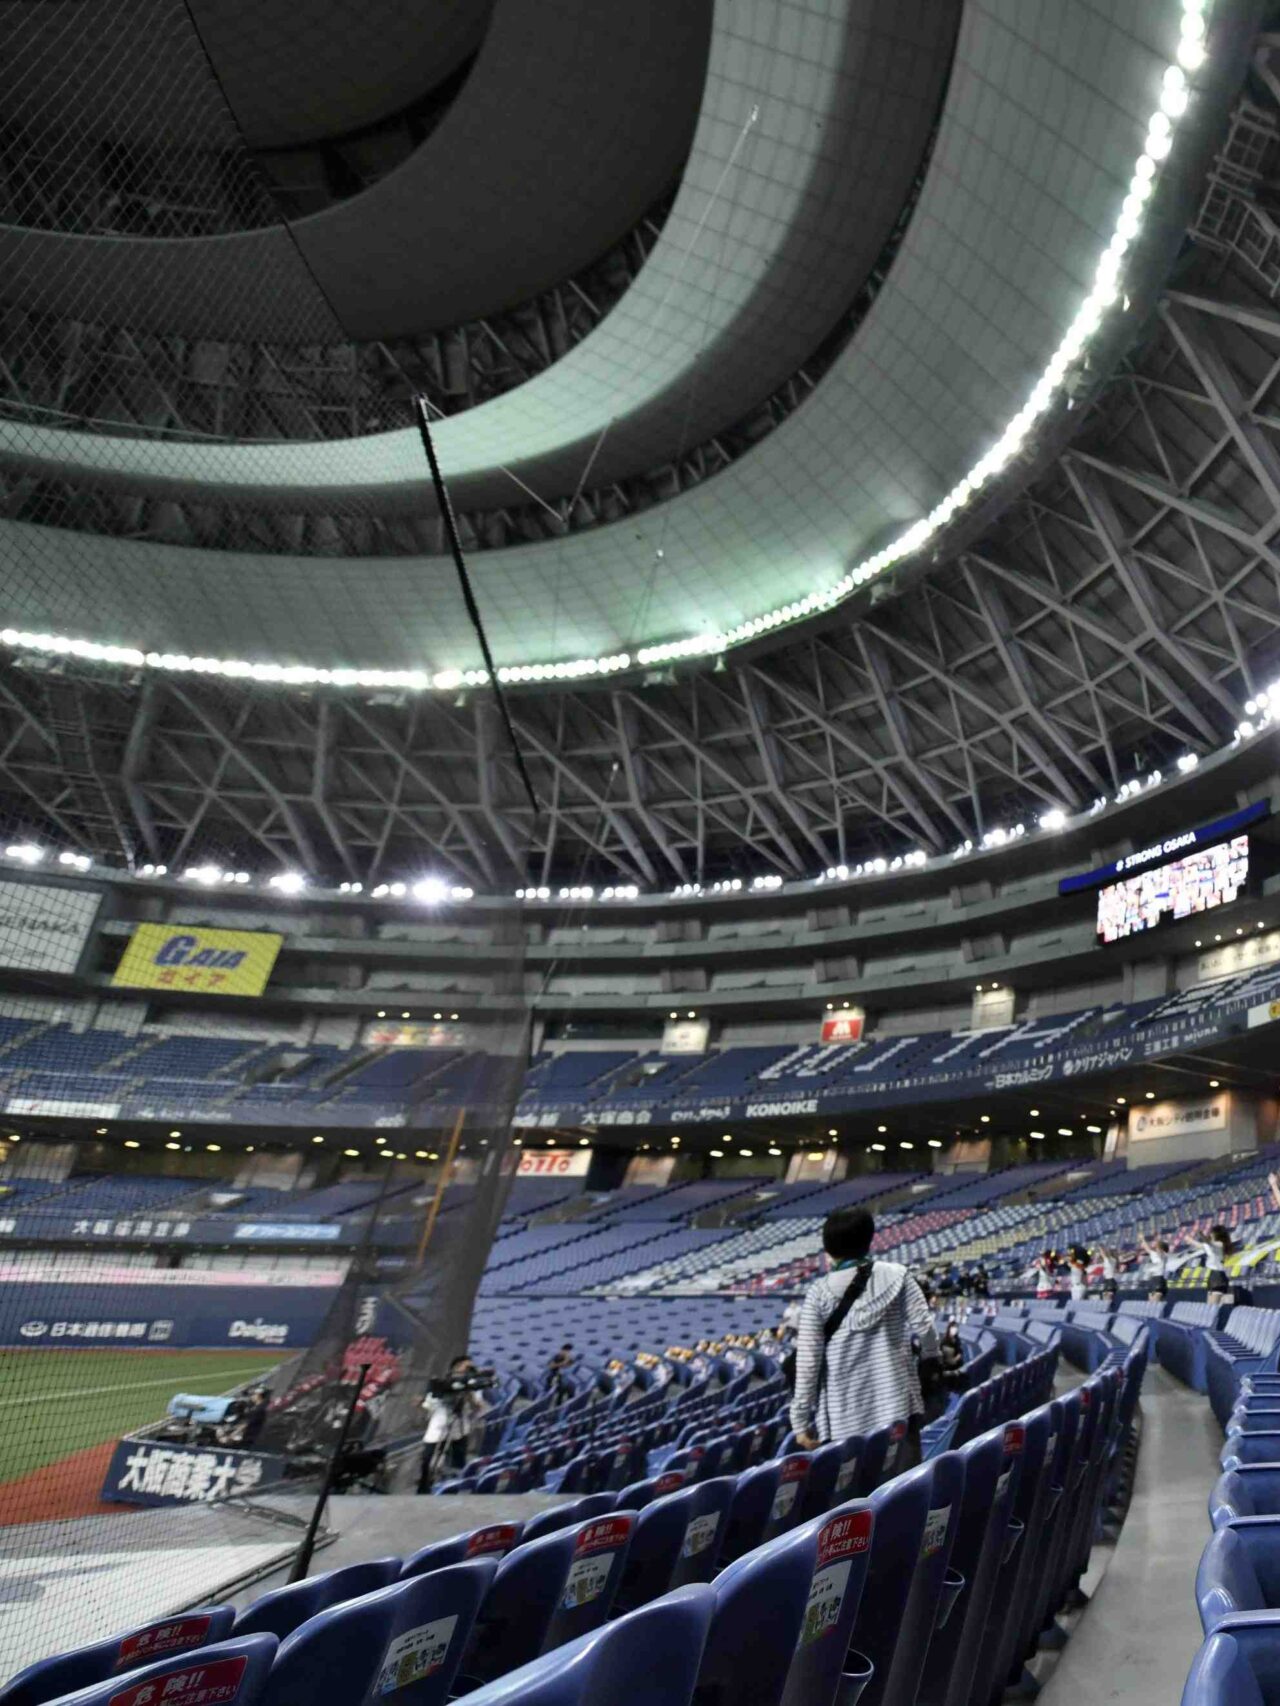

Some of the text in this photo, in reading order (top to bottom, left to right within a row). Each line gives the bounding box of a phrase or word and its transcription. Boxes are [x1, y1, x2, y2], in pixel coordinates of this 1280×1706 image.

[1125, 844, 1163, 869] STRONG
[1163, 831, 1197, 854] OSAKA
[153, 934, 248, 971] GAIA
[745, 1099, 818, 1118] KONOIKE
